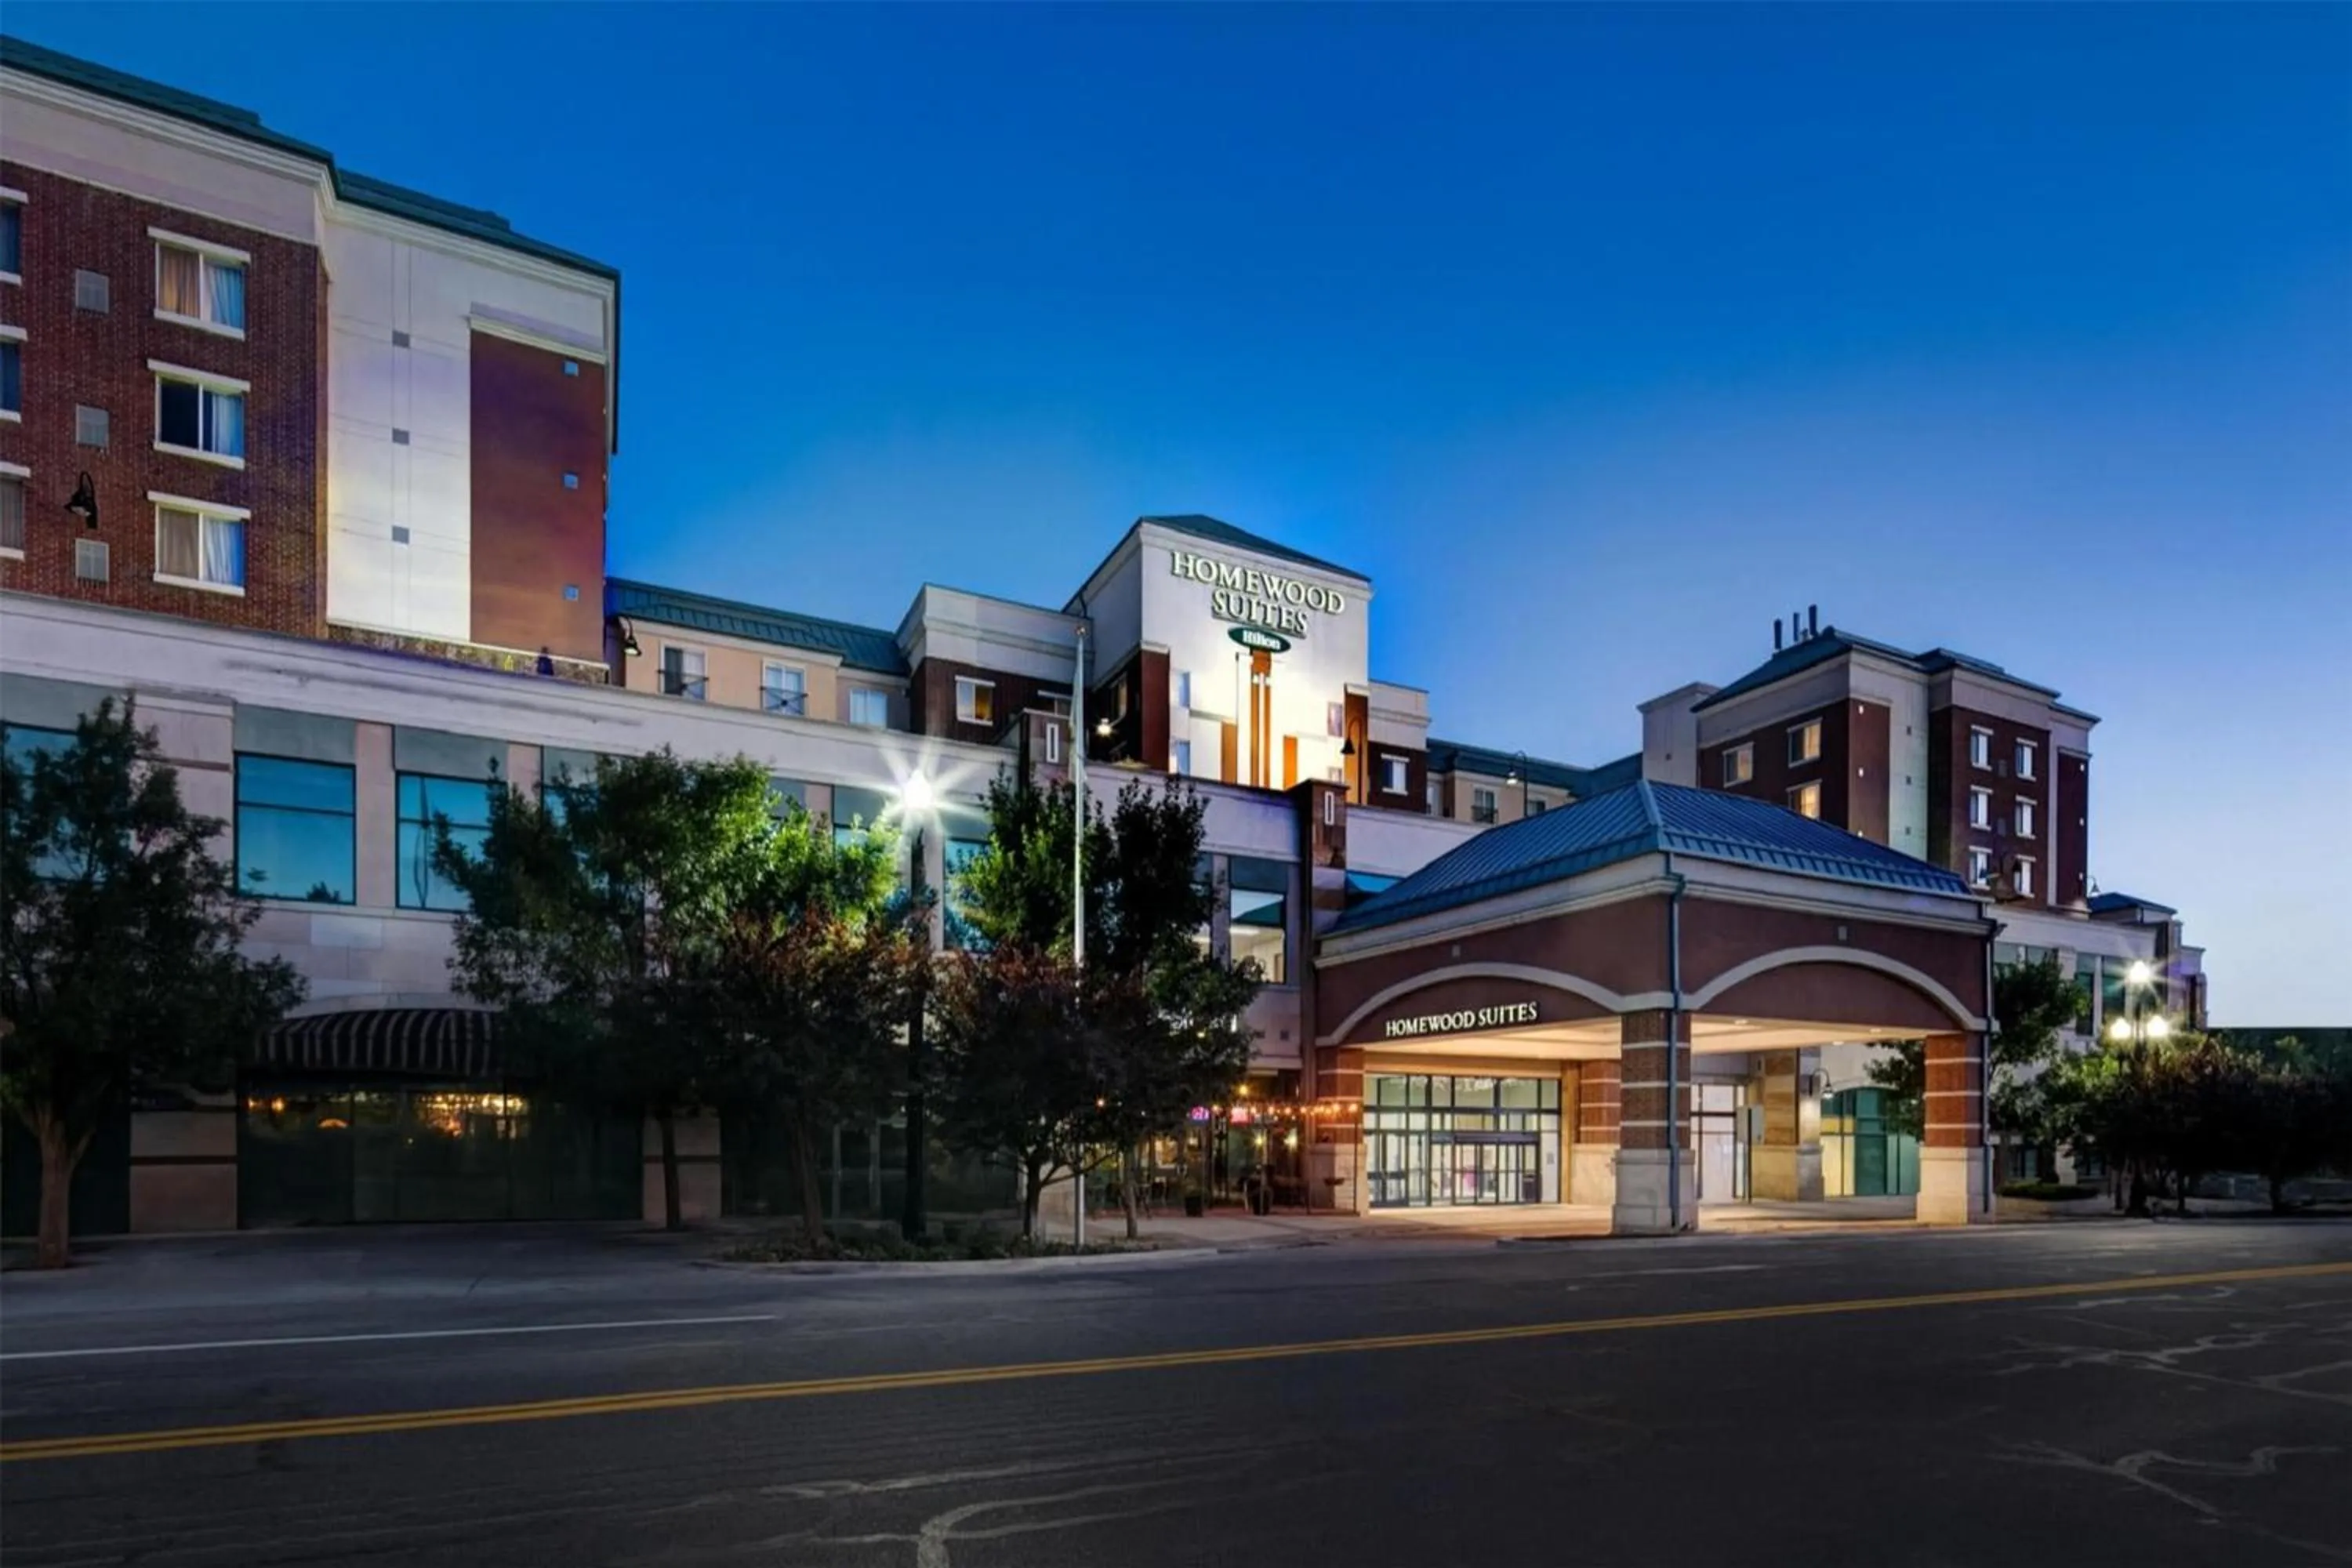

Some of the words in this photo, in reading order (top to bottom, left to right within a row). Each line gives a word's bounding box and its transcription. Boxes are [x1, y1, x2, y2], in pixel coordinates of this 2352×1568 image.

[1172, 551, 1345, 615] HOMEWOOD
[1212, 591, 1308, 633] SUITES
[1243, 630, 1281, 650] Hilton
[1385, 1010, 1475, 1037] HOMEWOOD
[1478, 1000, 1538, 1027] SUITES
